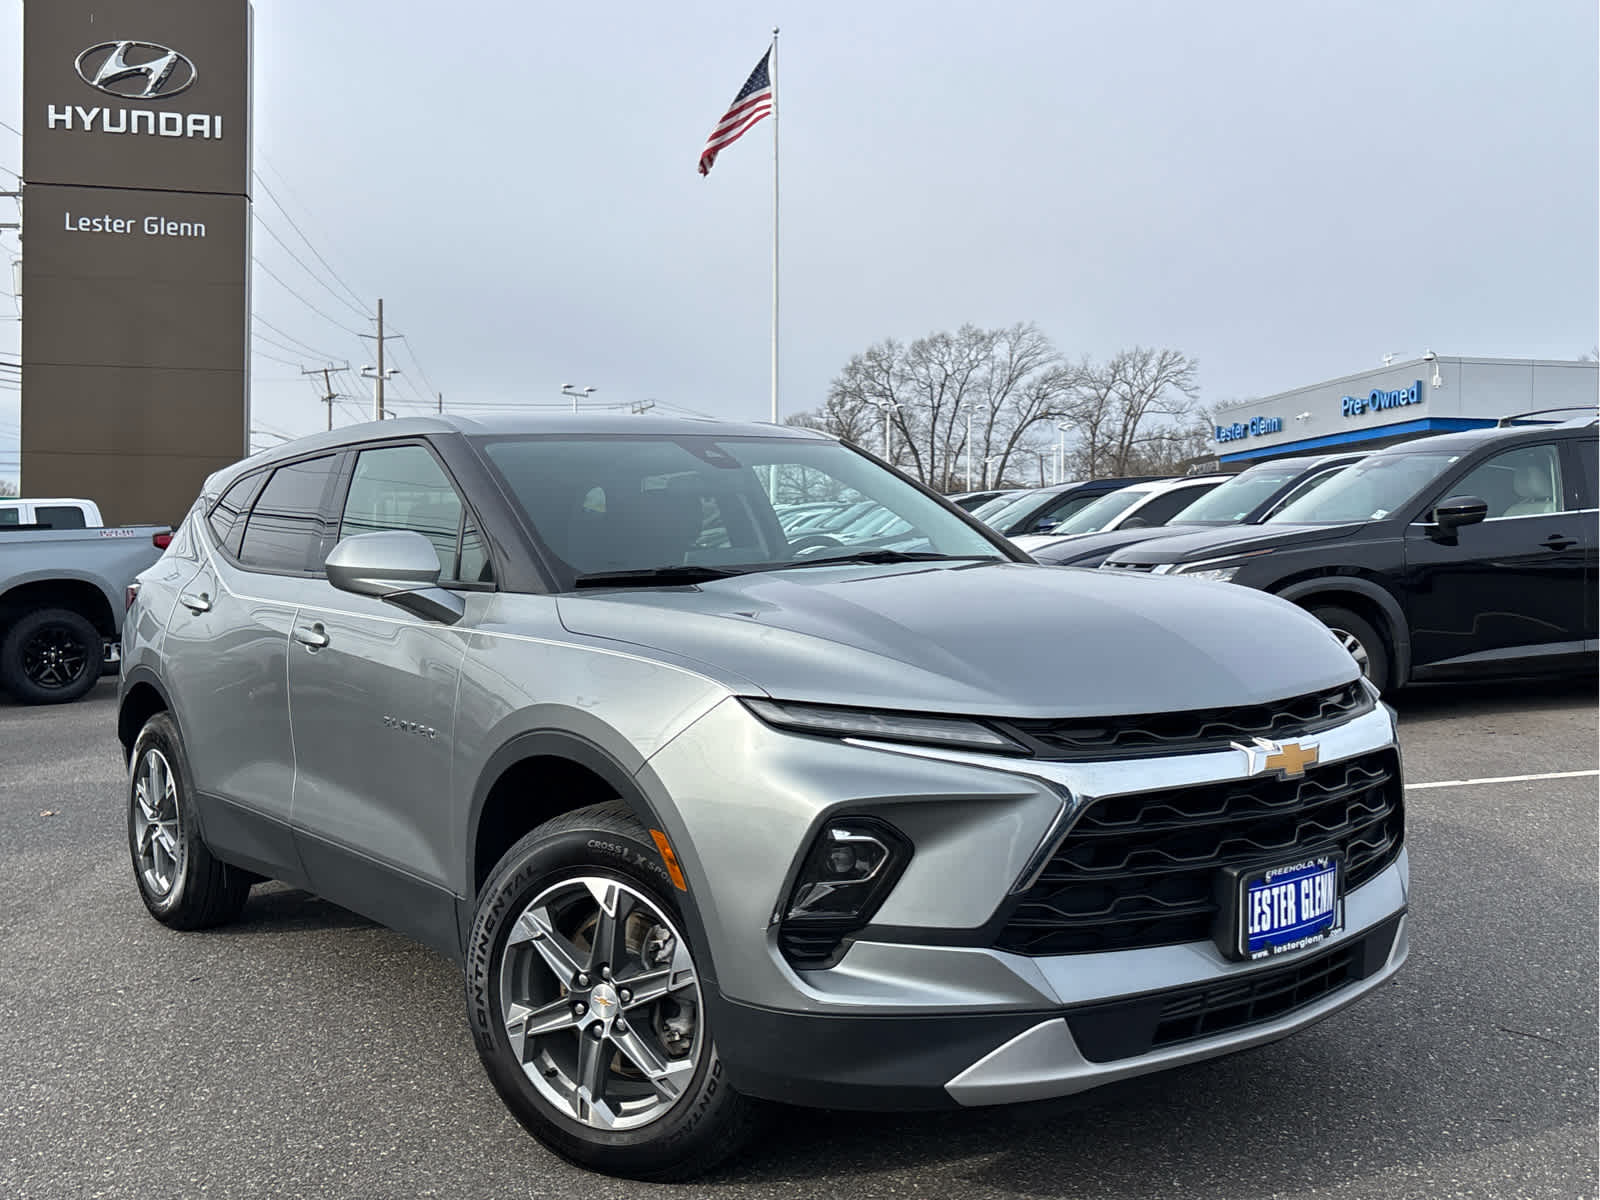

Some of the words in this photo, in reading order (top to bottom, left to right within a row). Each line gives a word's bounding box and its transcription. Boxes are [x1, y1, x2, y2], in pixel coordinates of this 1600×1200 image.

[47, 104, 222, 140] HYUNDAI
[64, 212, 136, 234] Lester
[143, 215, 206, 237] Glenn
[1341, 380, 1423, 417] Pre-Owned
[1215, 422, 1249, 443] Lester
[1250, 416, 1283, 436] Glenn
[587, 839, 623, 854] CROSS
[1248, 883, 1297, 934] LESTER
[1301, 870, 1335, 921] GLENN
[473, 864, 539, 1052] CONTINENTAL
